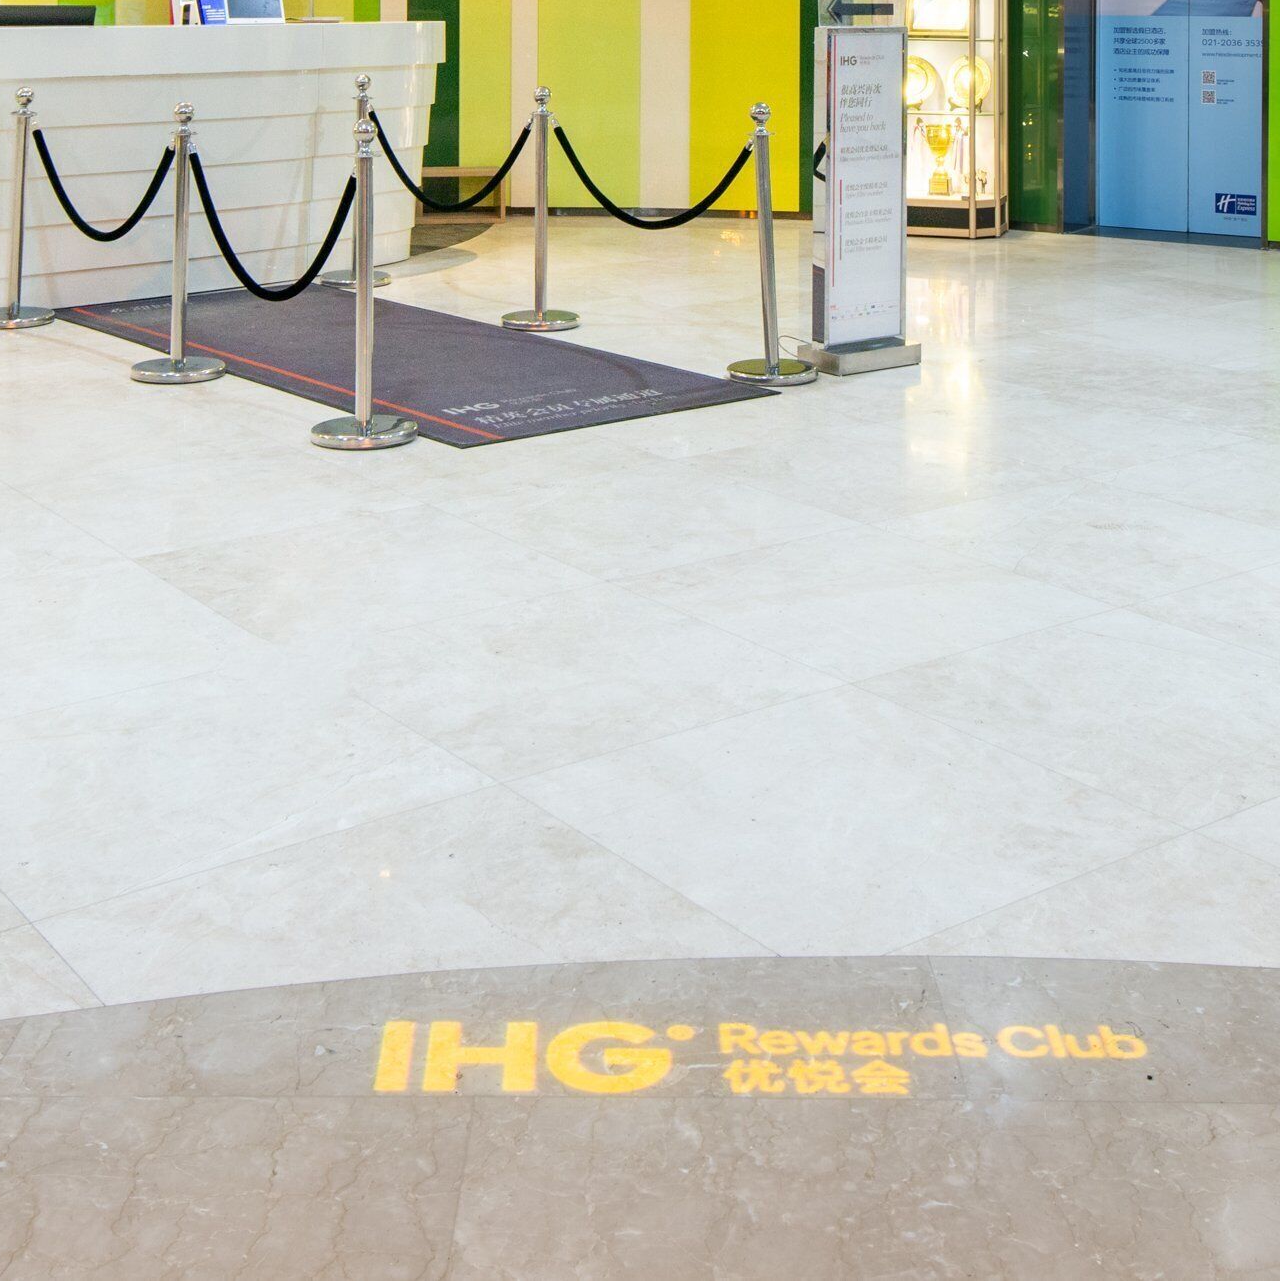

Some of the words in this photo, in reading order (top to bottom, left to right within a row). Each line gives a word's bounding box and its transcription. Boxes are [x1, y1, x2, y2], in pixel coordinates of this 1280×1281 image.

[840, 55, 857, 66] IHG
[441, 403, 500, 415] IHG
[373, 1021, 673, 1093] IHG
[718, 1022, 988, 1058] Rewards
[996, 1023, 1148, 1059] Club
[723, 1059, 912, 1095] 优悦会
